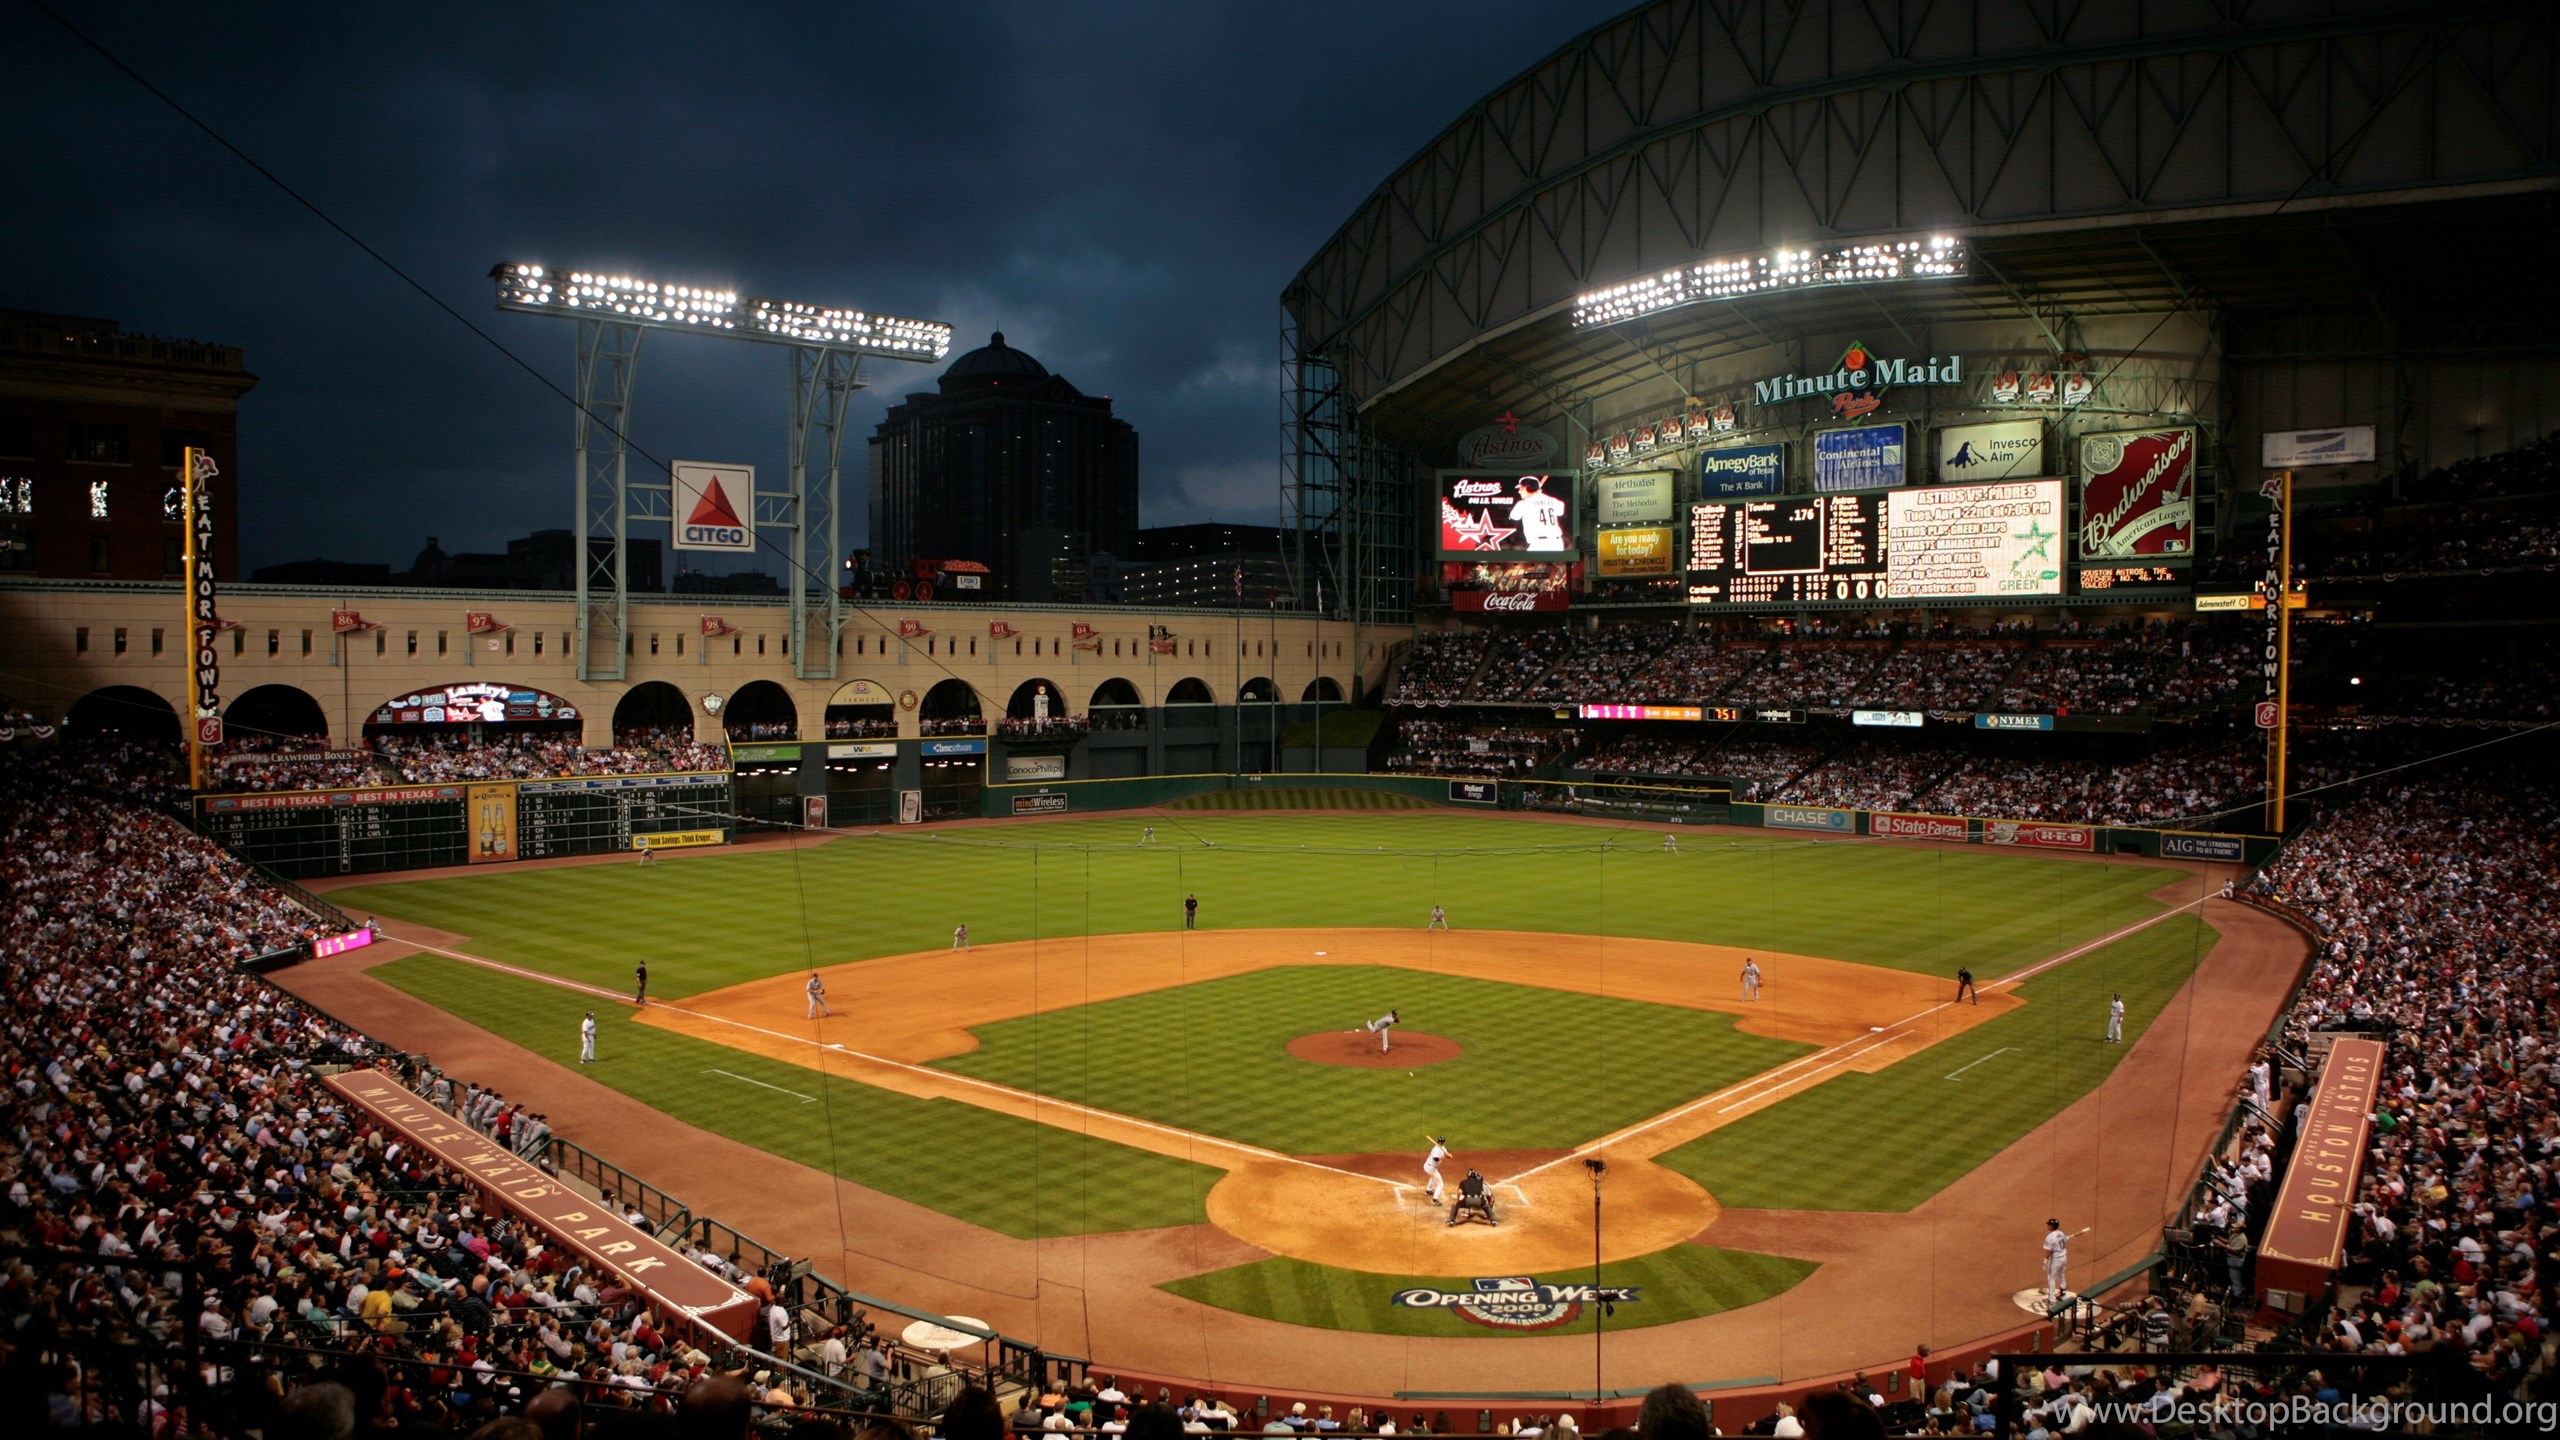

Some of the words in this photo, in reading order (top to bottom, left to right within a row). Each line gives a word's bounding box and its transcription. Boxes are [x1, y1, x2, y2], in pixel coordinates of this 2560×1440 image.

[1754, 365, 1867, 405] Minute
[1874, 355, 1961, 385] Maid
[1993, 371, 2016, 390] 49
[2027, 372, 2052, 390] 24
[2070, 373, 2082, 390] 5
[1713, 403, 1732, 420] 42
[1831, 391, 1880, 419] Park
[1662, 416, 1679, 433] 33
[1688, 411, 1706, 427] 34
[1610, 433, 1629, 449] 40
[1635, 426, 1652, 442] 25
[1470, 434, 1543, 464] Astros
[1585, 442, 1602, 458] 32
[1989, 438, 2037, 450] Invesco
[1818, 447, 1880, 461] Continental
[1990, 450, 2014, 462] Aim
[1705, 452, 1779, 473] AmegyBank
[1839, 457, 1881, 469] Airlines
[1748, 468, 1755, 476] of
[1757, 467, 1775, 475] Texas
[1453, 480, 1502, 498] Astros
[1612, 477, 1656, 491] Methodist
[1720, 483, 1734, 492] The
[1745, 481, 1763, 490] Bank
[2084, 431, 2190, 550] Budweiser
[1917, 490, 1965, 505] ASTROS
[1987, 485, 2037, 501] PADRES
[1612, 500, 1624, 509] The
[1626, 498, 1658, 508] Methodist
[1692, 504, 1726, 514] Cardinals
[1748, 503, 1776, 512] Towles
[1934, 507, 1961, 521] April
[1962, 505, 1991, 519] 22nd
[1993, 506, 2004, 518] at
[2004, 503, 2031, 517] 7:05
[2031, 501, 2051, 515] PM
[1539, 508, 1556, 526] 46
[1612, 508, 1639, 519] Hospital
[197, 494, 212, 550] EAT
[1890, 526, 1927, 538] ASTROS
[1927, 524, 1949, 537] PLAY
[1950, 523, 1981, 536] GREEN
[1981, 521, 2008, 534] CAPS
[2115, 517, 2157, 550] American
[2159, 508, 2187, 521] Lager
[686, 526, 743, 544] CITGO
[1610, 534, 1623, 545] Are
[1624, 534, 1638, 545] you
[1639, 532, 1660, 545] ready
[2267, 513, 2280, 563] EAT
[1616, 545, 1627, 556] for
[1628, 544, 1654, 557] today?
[1890, 541, 1902, 552] BY
[1936, 536, 2001, 550] MANAGEMENT
[1875, 572, 1887, 580] OUT
[1913, 568, 1925, 580] by
[1925, 567, 1970, 580] Sections
[2013, 570, 2037, 579] PLAY
[197, 561, 213, 620] MOR
[1889, 583, 1909, 594] 323
[1910, 584, 1920, 594] or
[1920, 582, 1976, 594] astros.com
[1999, 579, 2040, 591] GREEN
[2265, 569, 2278, 620] MOR
[338, 615, 353, 625] 86
[472, 616, 487, 626] 97
[706, 620, 719, 630] 98
[905, 623, 916, 631] 99
[994, 624, 1004, 633] 01
[200, 628, 215, 707] FOWL
[2263, 627, 2278, 696] FOWL
[444, 683, 510, 699] Landry's
[1998, 715, 2040, 725] NYMEX
[271, 752, 322, 762] CRAWFORD
[324, 750, 353, 761] BOXES
[1008, 761, 1062, 775] ConocoPhillips
[241, 798, 270, 808] BEST
[274, 797, 286, 806] IN
[289, 795, 326, 805] TEXAS
[356, 792, 386, 802] BEST
[388, 792, 399, 800] IN
[401, 790, 434, 800] TEXAS
[778, 797, 792, 805] 362
[1773, 809, 1827, 825] CHASE
[1891, 817, 1926, 834] State
[1927, 820, 1962, 837] Farm
[648, 837, 661, 845] Think
[681, 834, 694, 843] Think
[2166, 839, 2193, 852] AIG
[2300, 1123, 2352, 1223] HOUSTON
[2334, 1056, 2370, 1112] ASTROS
[360, 1088, 461, 1143] MINUTE
[460, 1151, 549, 1200] MAID
[557, 1209, 668, 1273] PARK
[1400, 1289, 1539, 1307] OPENING
[1491, 1303, 1548, 1314] 2008
